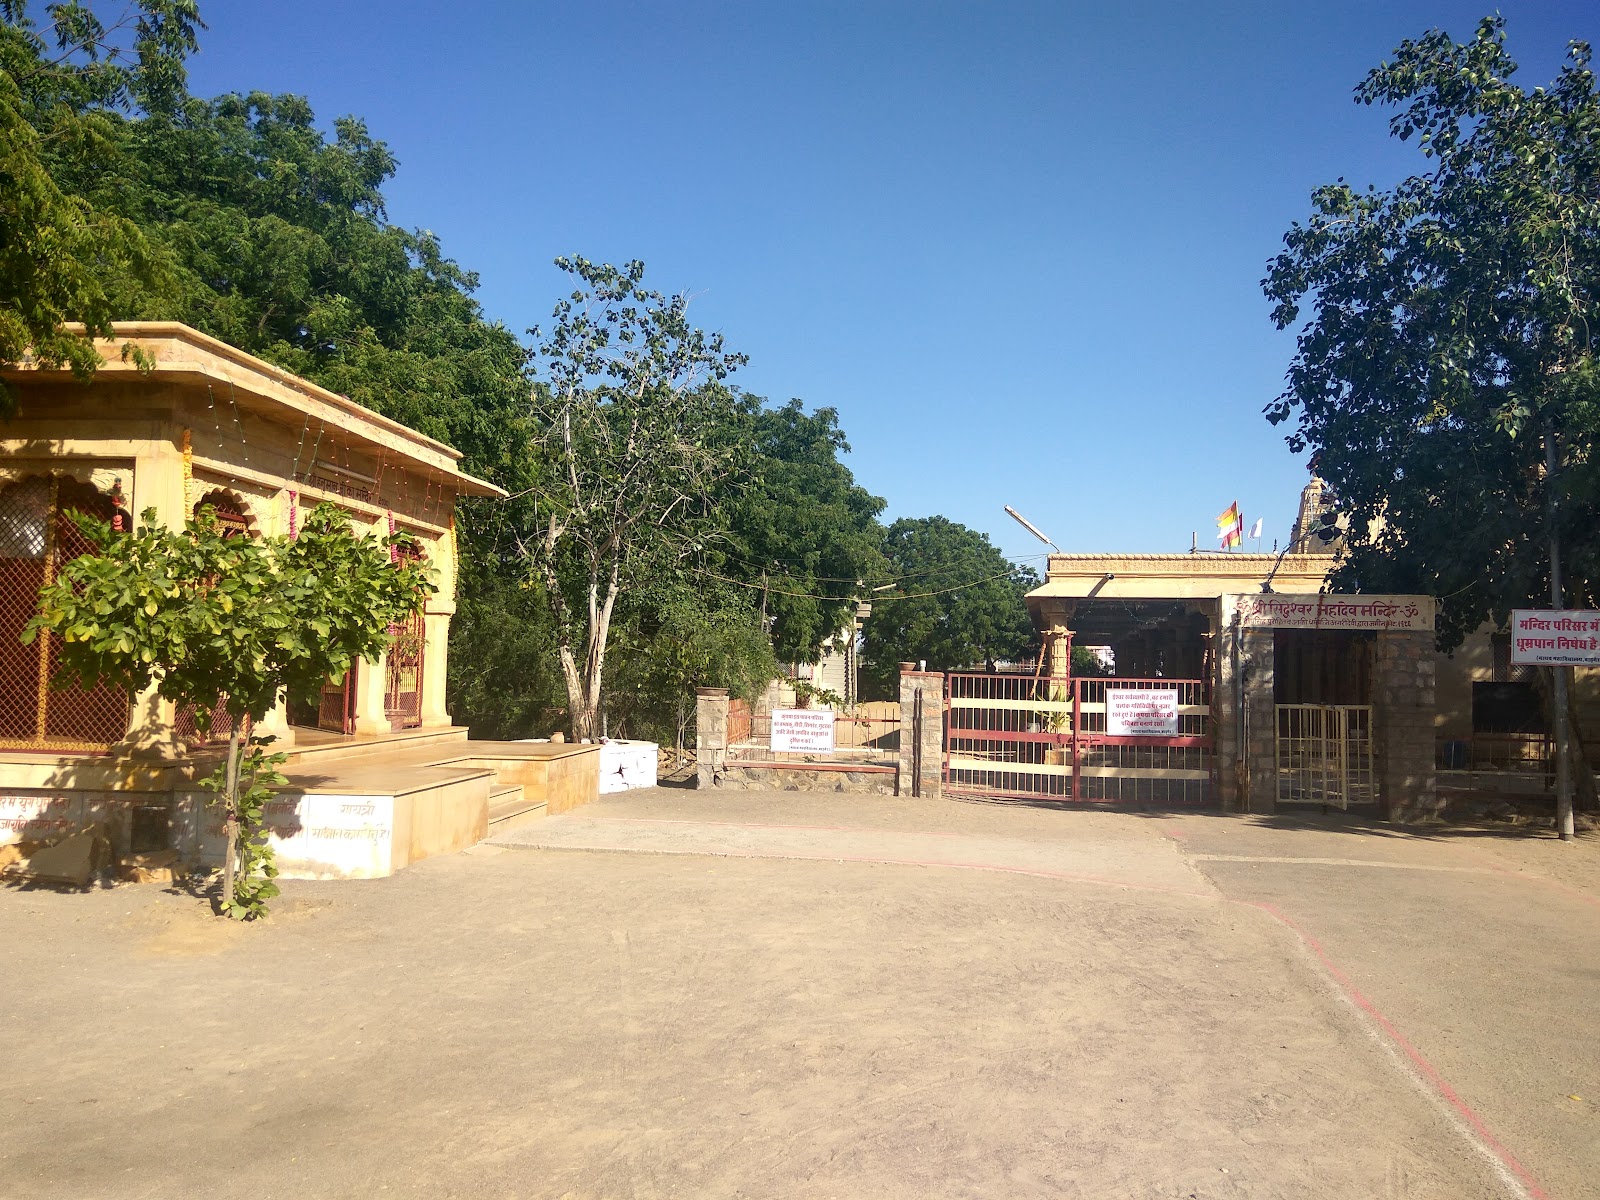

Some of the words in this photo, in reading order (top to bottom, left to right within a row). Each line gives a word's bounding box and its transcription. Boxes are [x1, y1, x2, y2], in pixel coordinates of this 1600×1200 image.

[1519, 618, 1551, 630] मन्दिर
[1553, 618, 1588, 631] परिसर
[1516, 638, 1555, 652] धूम्रपान
[1557, 636, 1588, 650] निषेध
